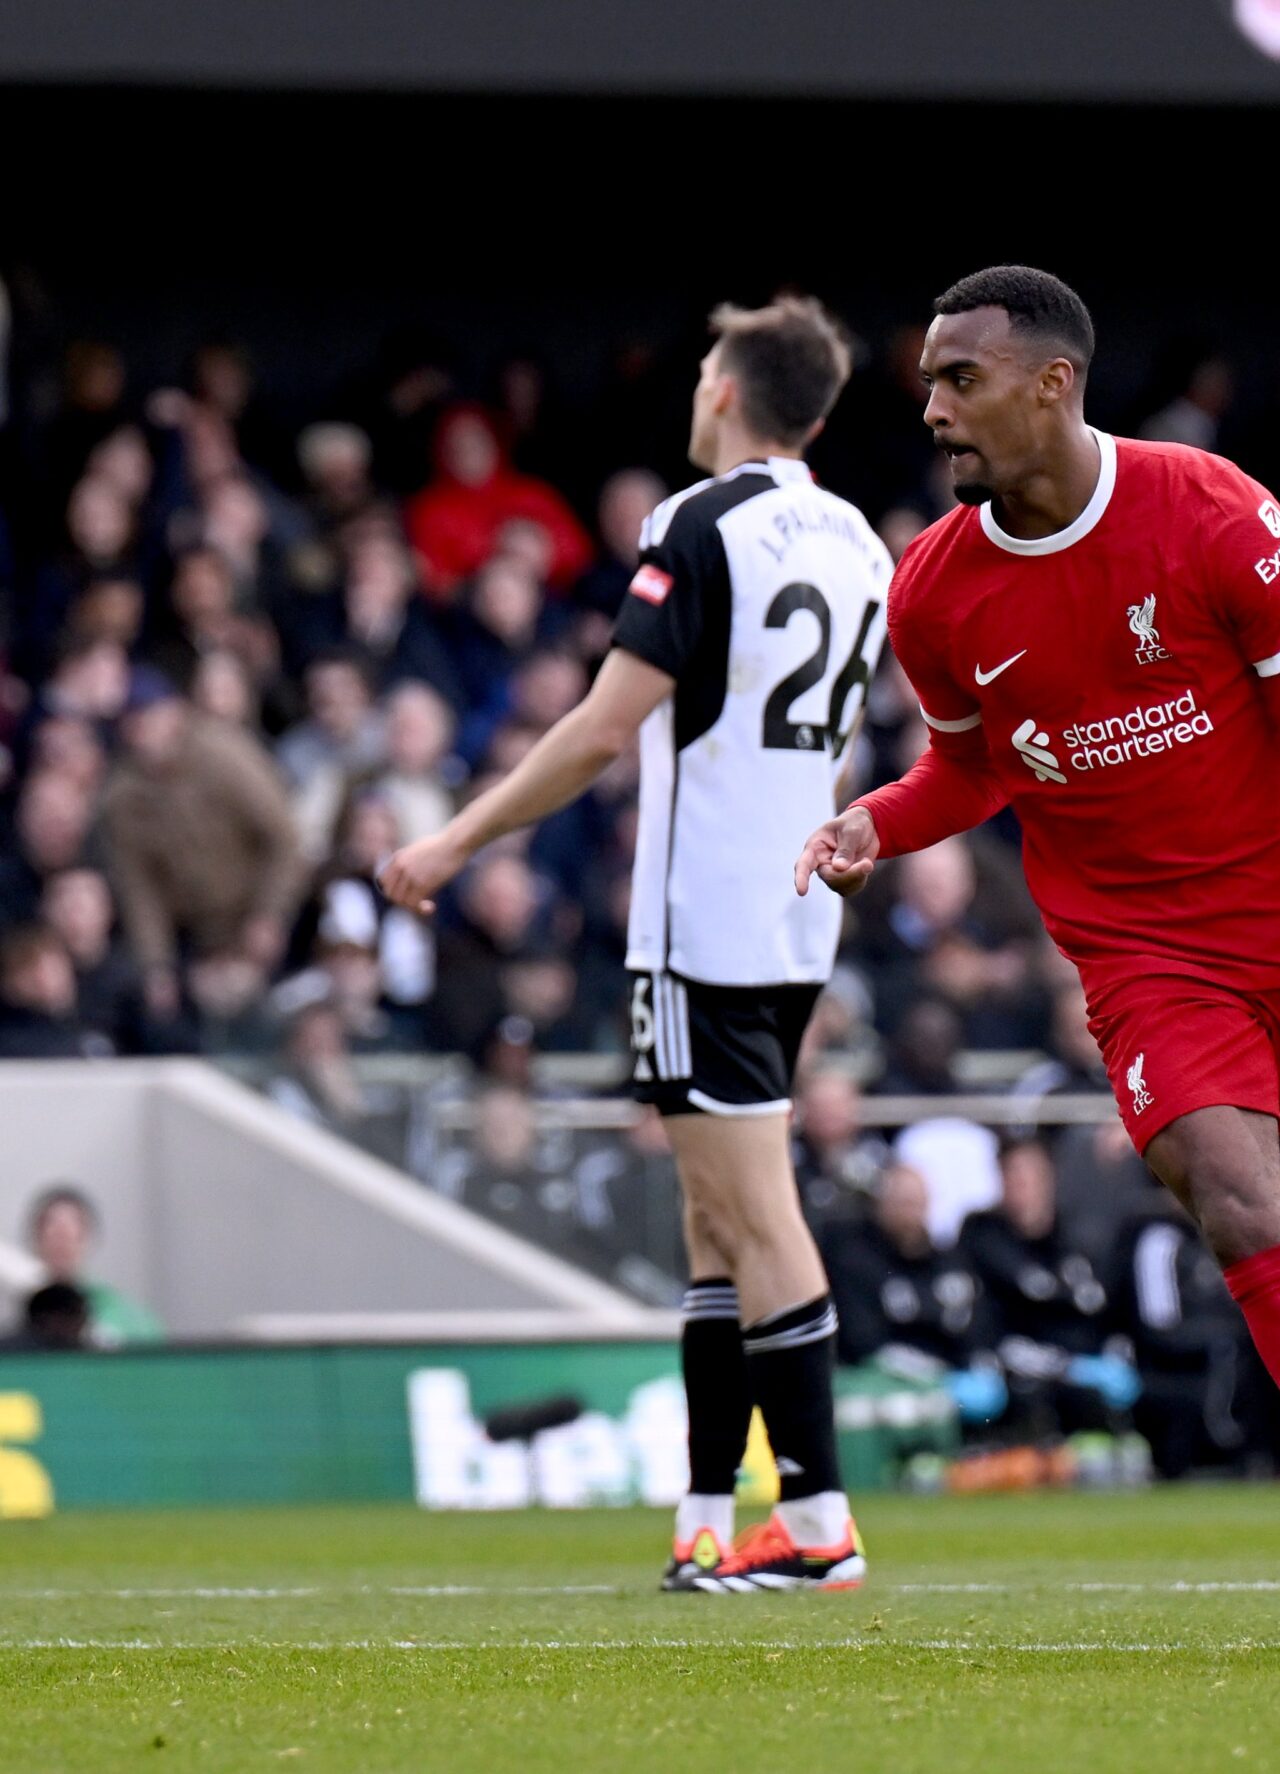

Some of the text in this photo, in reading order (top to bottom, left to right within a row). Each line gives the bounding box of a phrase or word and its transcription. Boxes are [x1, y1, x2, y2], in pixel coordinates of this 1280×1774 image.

[762, 581, 880, 761] 26
[1063, 689, 1197, 748] standard
[1071, 710, 1214, 771] chartered
